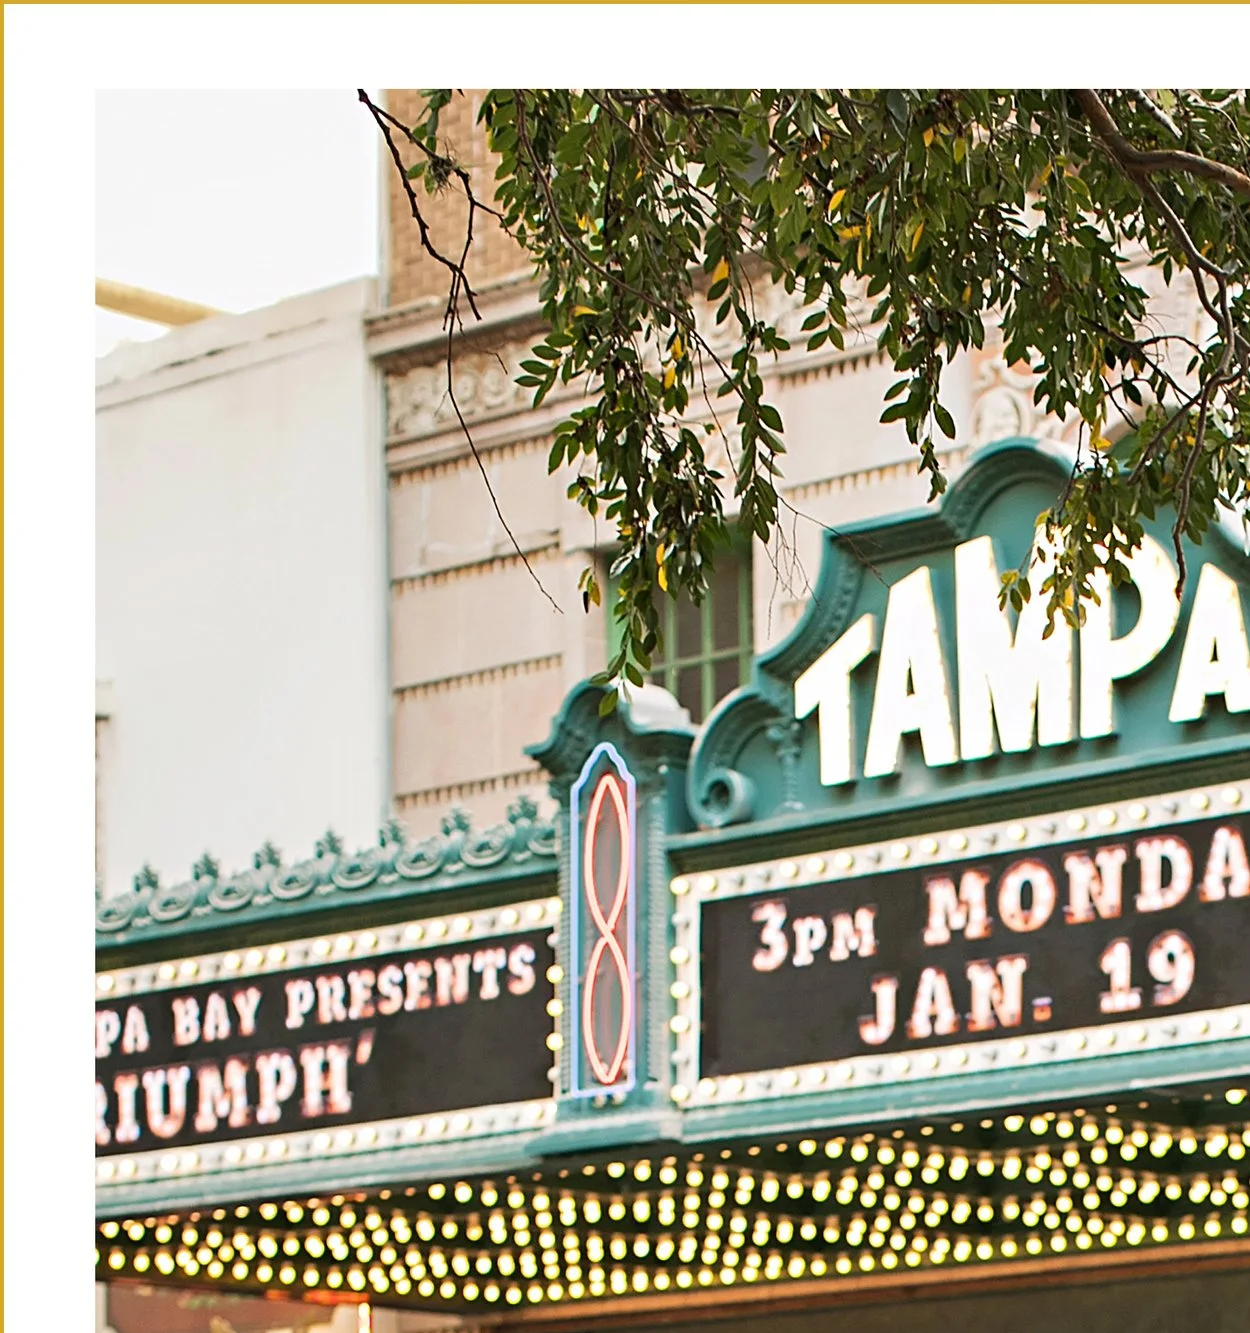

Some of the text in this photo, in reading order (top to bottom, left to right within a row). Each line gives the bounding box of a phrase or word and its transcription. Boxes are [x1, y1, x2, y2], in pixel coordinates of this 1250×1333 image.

[172, 987, 262, 1046] BAY
[284, 943, 536, 1029] PRESENTS
[858, 930, 1195, 1045] JAN. 19
